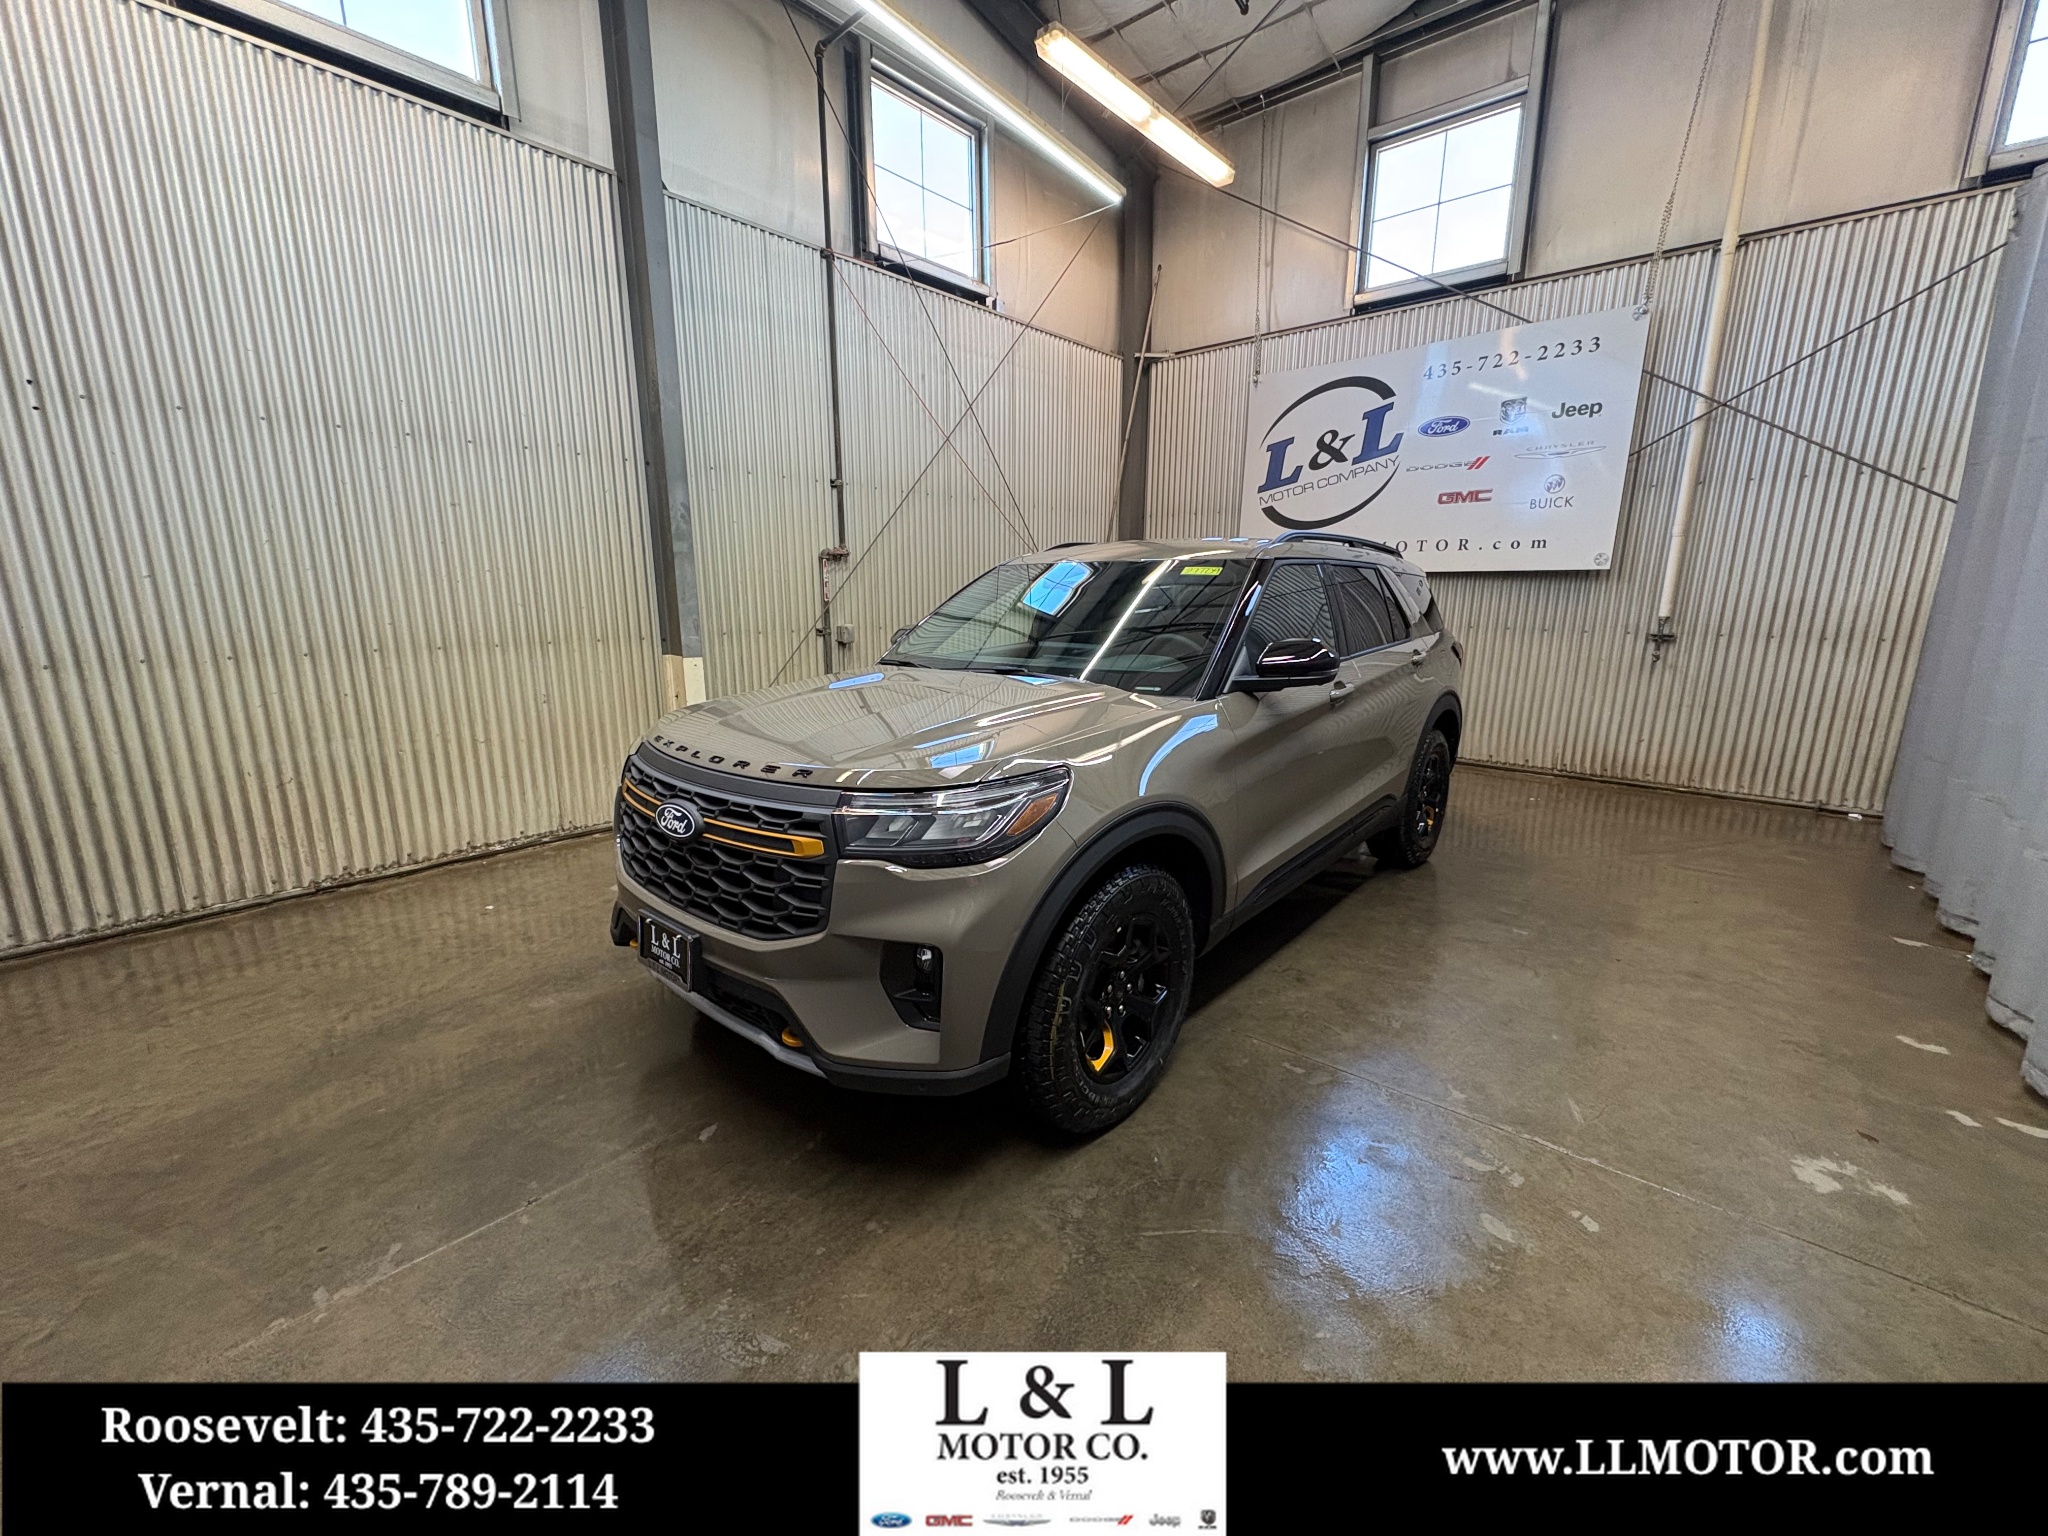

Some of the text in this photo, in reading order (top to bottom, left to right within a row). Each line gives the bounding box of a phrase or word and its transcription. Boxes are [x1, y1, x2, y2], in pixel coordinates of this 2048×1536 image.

[1423, 336, 1601, 380] 435-722-2233
[1551, 402, 1603, 418] Jeep
[1526, 440, 1595, 451] CHRYSLER
[1406, 460, 1477, 472] DODGE
[1259, 455, 1400, 506] MOTOR COMPANY
[1437, 488, 1493, 505] GMC
[1529, 496, 1575, 509] BUICK
[1383, 538, 1547, 553] OTOR.com
[653, 735, 814, 778] EXPLORER
[660, 807, 688, 834] Ford
[650, 924, 680, 959] L & L
[651, 944, 671, 962] MOTOR
